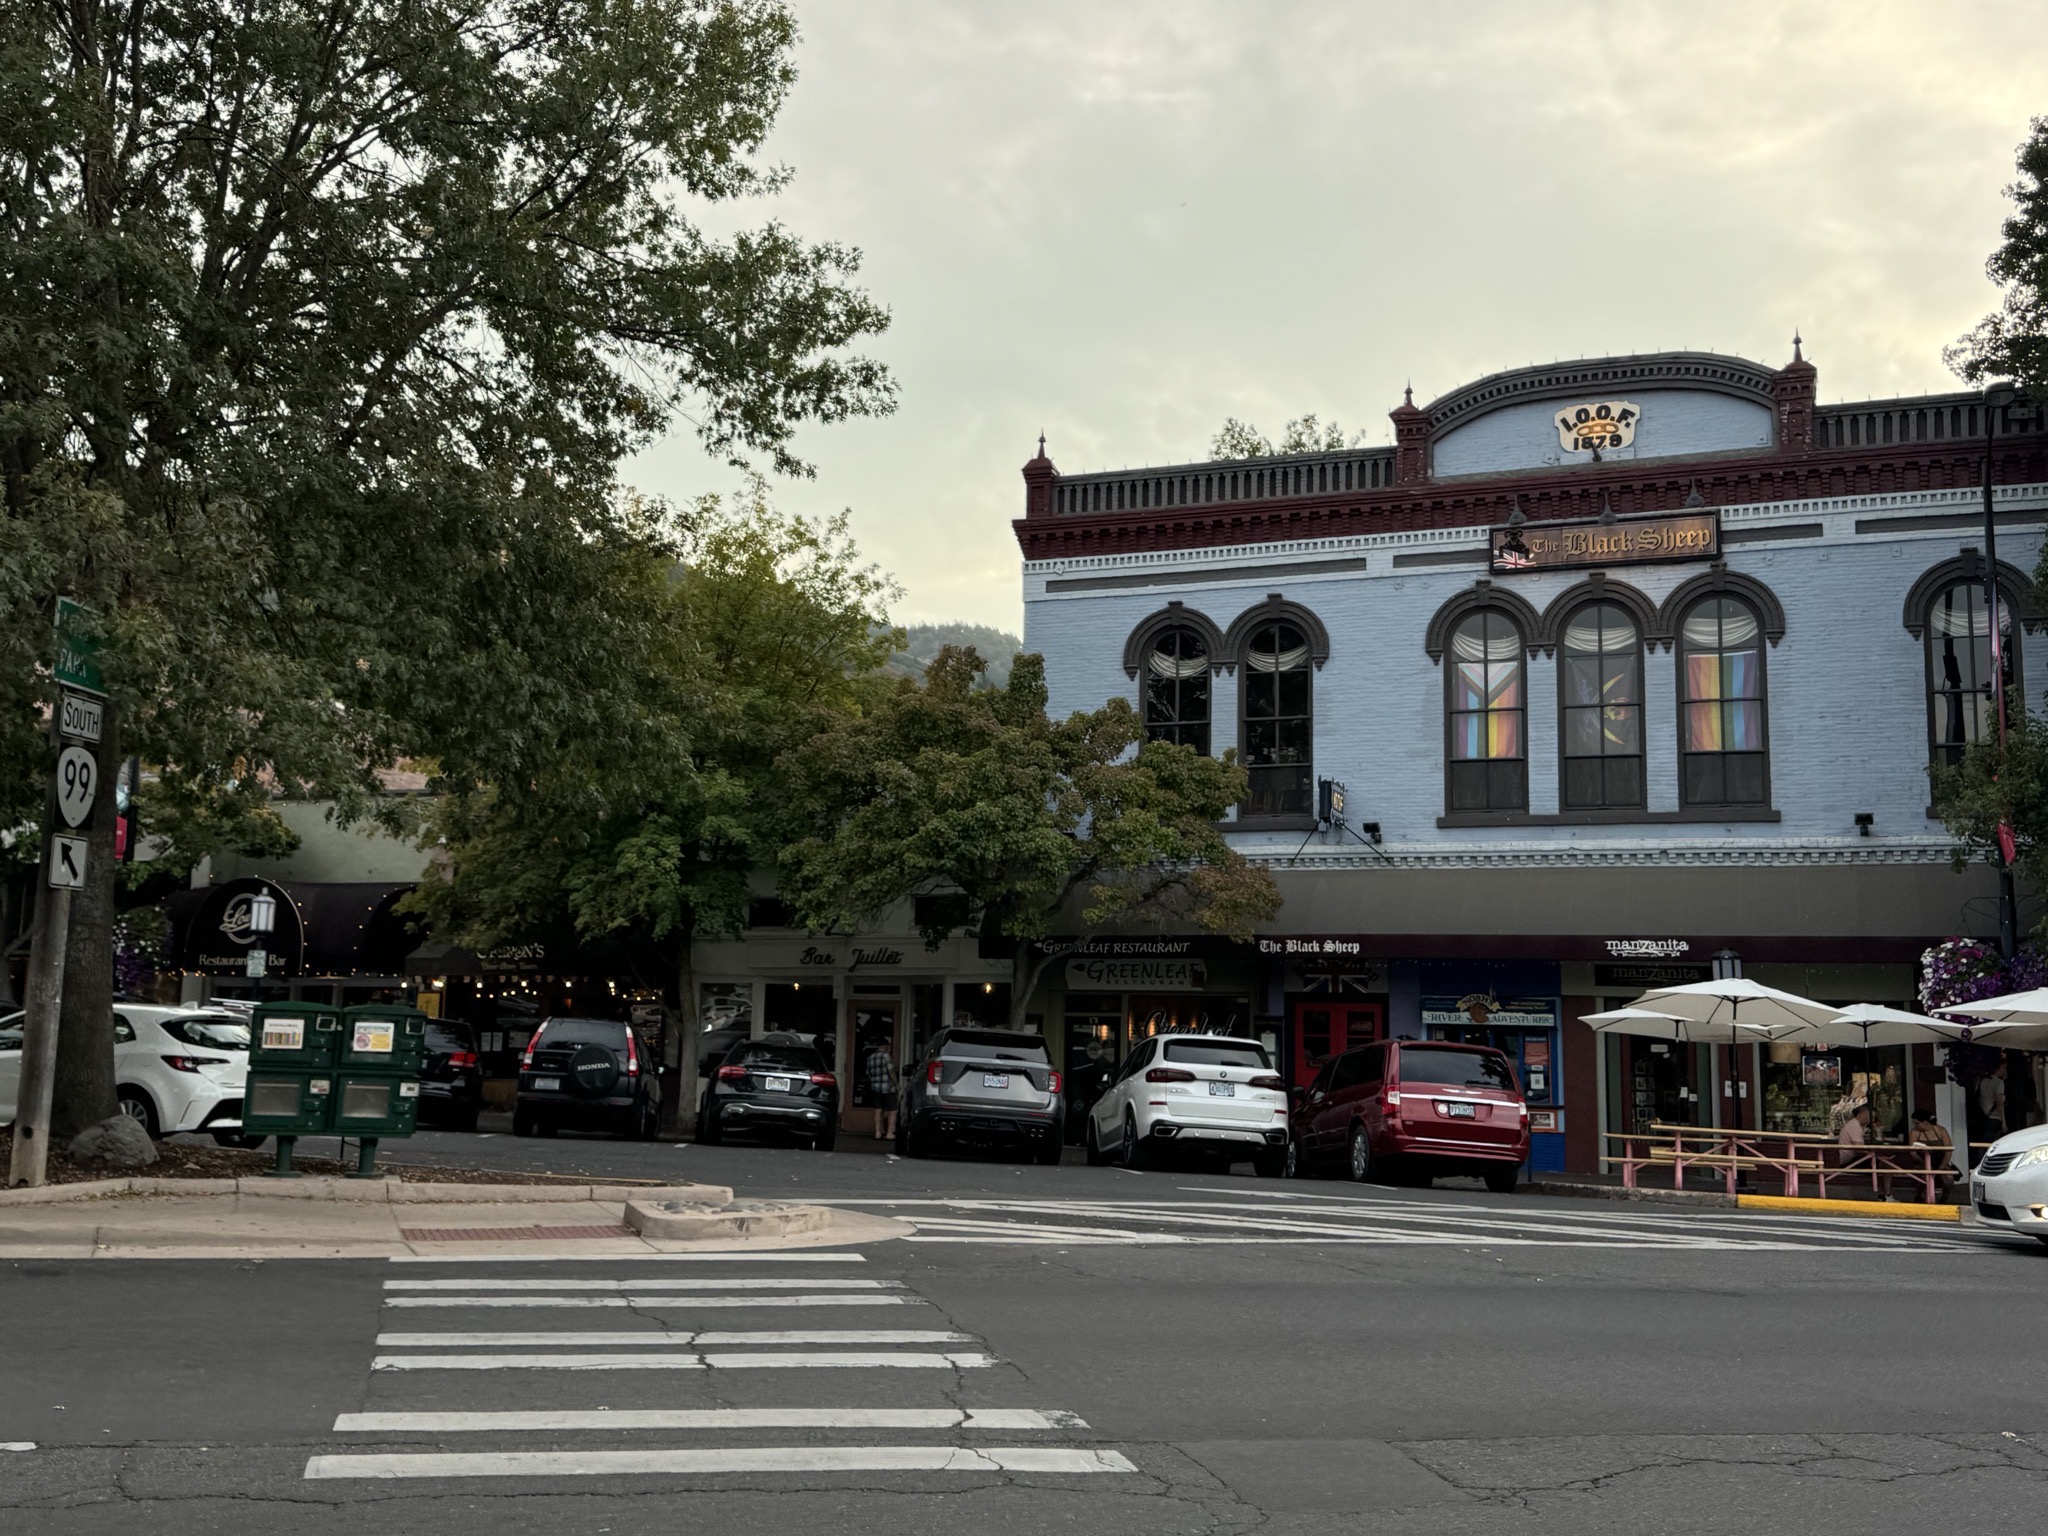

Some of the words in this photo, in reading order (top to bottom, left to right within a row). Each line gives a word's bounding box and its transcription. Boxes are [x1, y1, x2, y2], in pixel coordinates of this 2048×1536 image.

[1560, 404, 1636, 433] I.O.O.F.
[1531, 539, 1560, 555] The
[1561, 530, 1635, 560] Black
[1636, 526, 1711, 553] Sheep
[64, 702, 99, 731] SOUTH
[65, 759, 91, 804] 99
[1113, 941, 1191, 954] RESTAURANT
[1259, 940, 1282, 954] The
[1285, 939, 1321, 954] Black
[1322, 939, 1361, 954] Sheep
[1604, 939, 1690, 952] manzanita
[199, 954, 248, 966] Restauran
[268, 954, 288, 966] Bar
[800, 947, 836, 965] Bar
[848, 947, 904, 973] Juillet
[1087, 960, 1200, 983] GREENLEAF
[1611, 966, 1701, 980] manzanita
[1429, 1013, 1462, 1023] RIVER
[577, 1062, 611, 1072] HONDA
